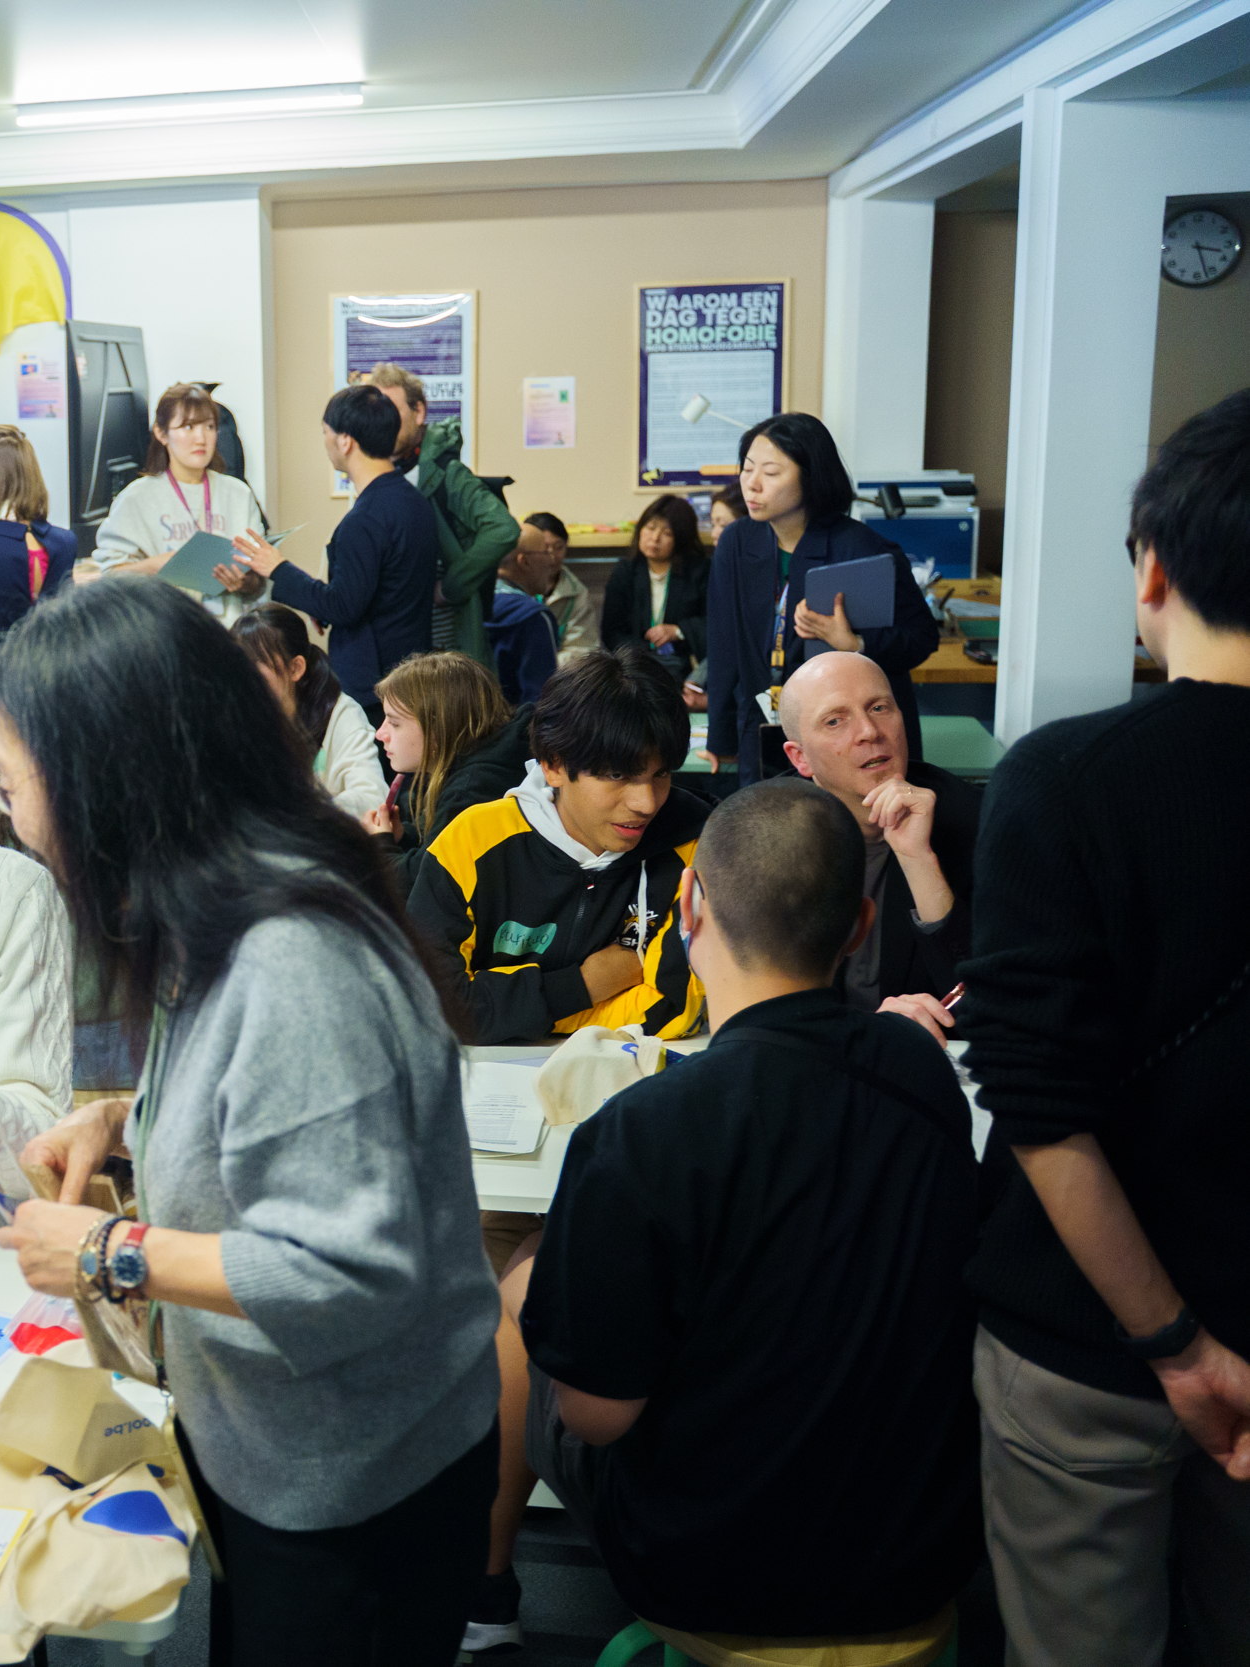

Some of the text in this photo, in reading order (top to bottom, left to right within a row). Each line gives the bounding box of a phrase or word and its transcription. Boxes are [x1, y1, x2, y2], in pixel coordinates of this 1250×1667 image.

[645, 291, 778, 311] WAAROM EEN
[646, 307, 778, 327] DAG TEGEN
[646, 324, 777, 345] HOMOFOBIE
